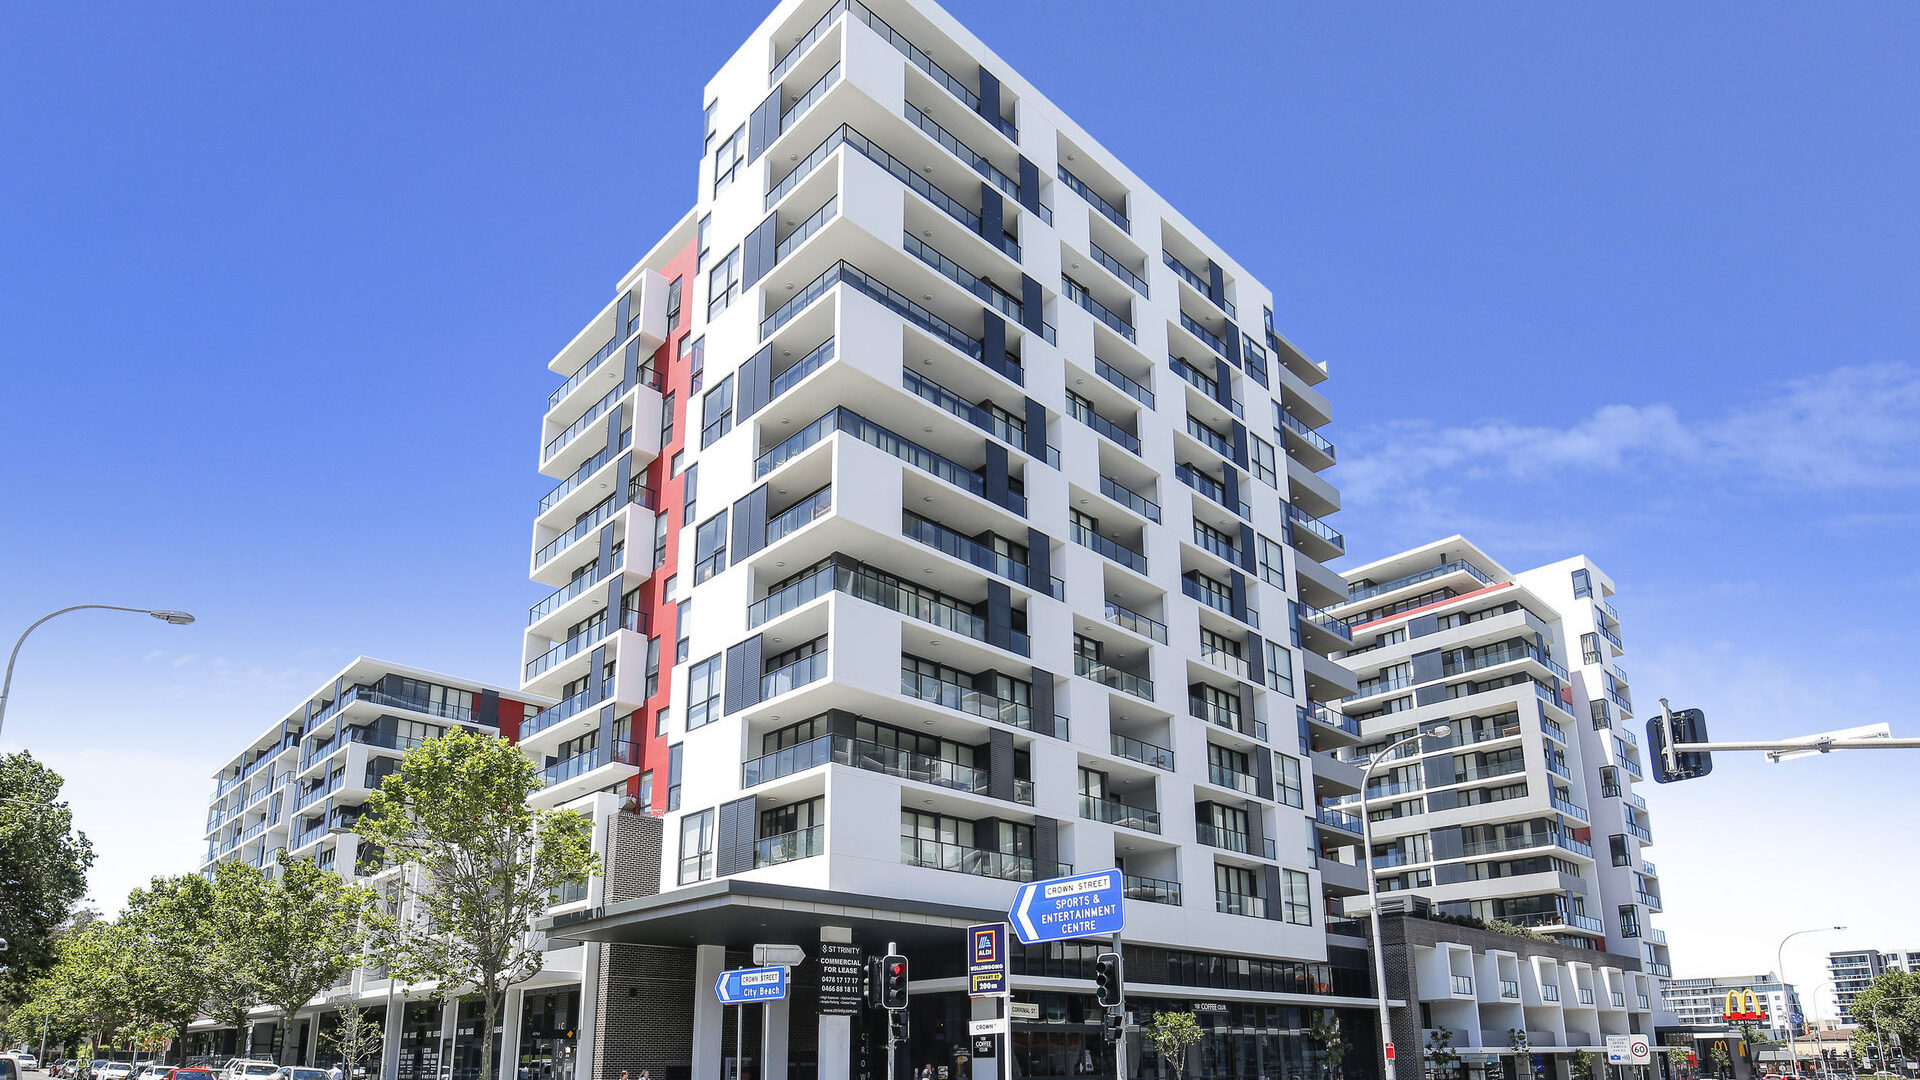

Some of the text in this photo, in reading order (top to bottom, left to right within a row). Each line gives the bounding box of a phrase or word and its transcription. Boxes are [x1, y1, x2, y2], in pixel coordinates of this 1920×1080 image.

[1046, 878, 1108, 896] CROWN STREET
[1055, 893, 1100, 910] SPORTS &
[1041, 904, 1116, 924] ENTERTAINMENT
[1061, 920, 1097, 934] CENTRE
[828, 945, 860, 955] ST TRINITY
[820, 957, 861, 966] COMMERCIAL
[838, 966, 858, 974] LEASE
[970, 963, 1004, 972] WOLLONGONG
[760, 973, 778, 982] STREET
[743, 984, 780, 998] City Beach
[836, 985, 844, 993] 88
[1634, 1046, 1646, 1054] 60
